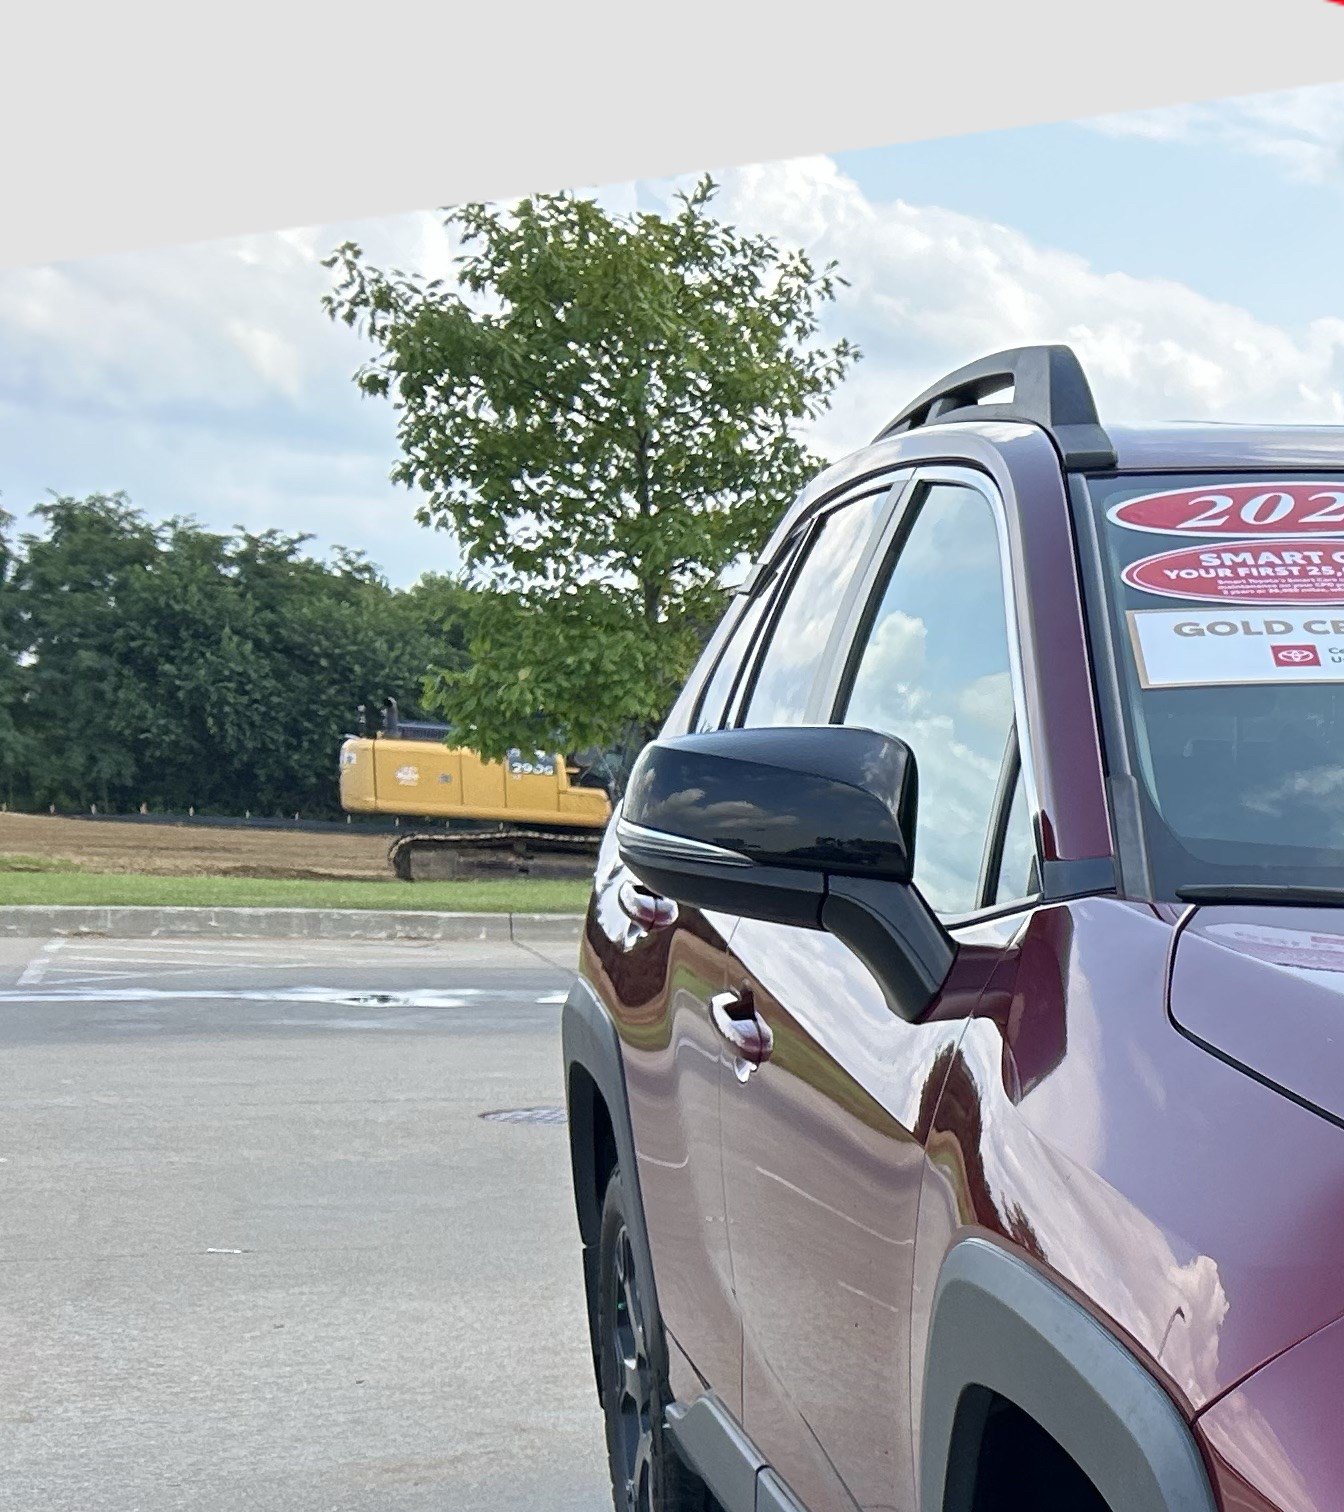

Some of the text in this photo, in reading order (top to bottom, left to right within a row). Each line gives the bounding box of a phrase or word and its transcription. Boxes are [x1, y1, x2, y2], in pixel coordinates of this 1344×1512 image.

[1199, 551, 1324, 566] SMART
[1163, 567, 1235, 580] YOUR
[1237, 566, 1302, 578] FIRST
[1173, 620, 1294, 638] GOLD
